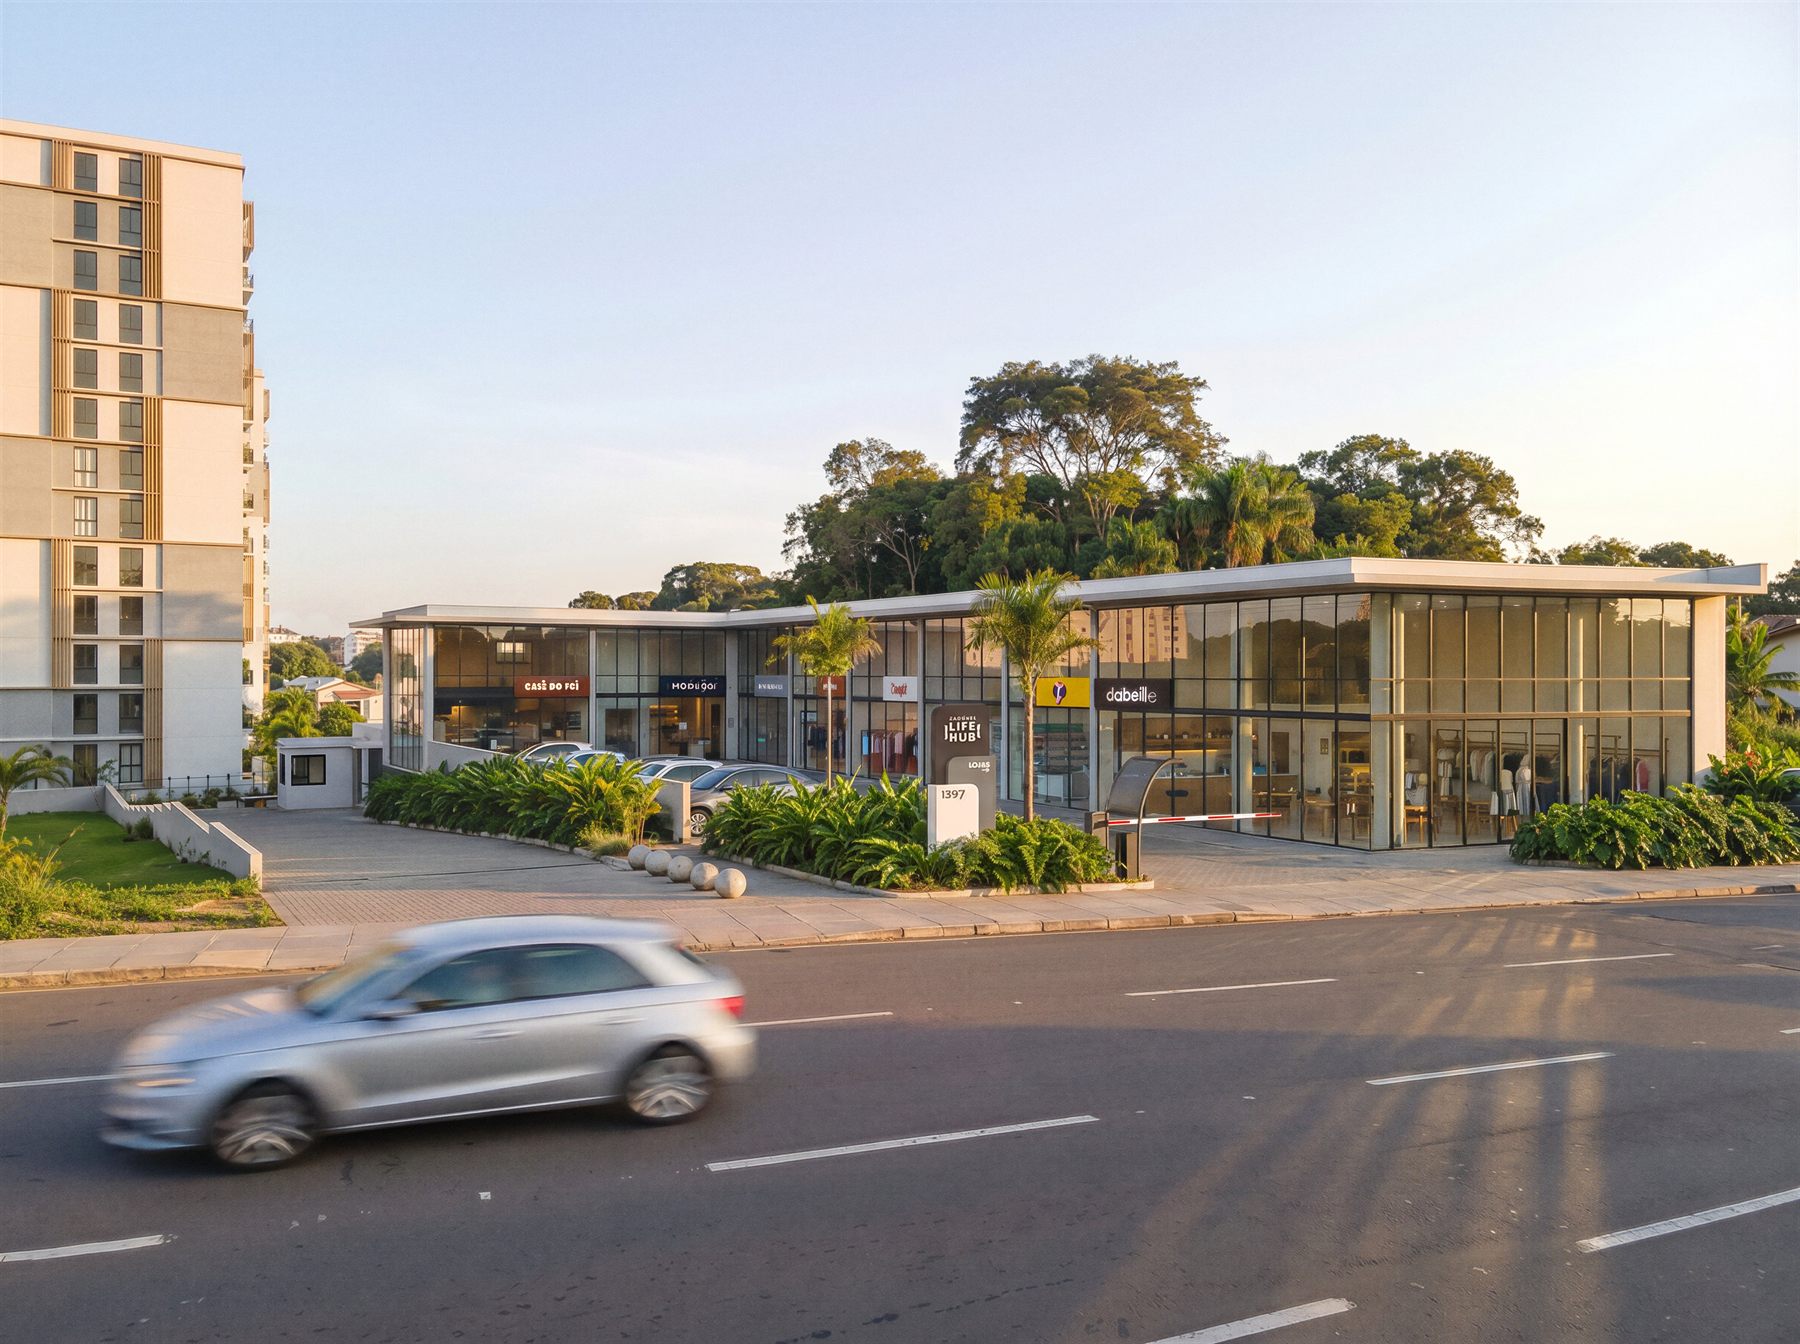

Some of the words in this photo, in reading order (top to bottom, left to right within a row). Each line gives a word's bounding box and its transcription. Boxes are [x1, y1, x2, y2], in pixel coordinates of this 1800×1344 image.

[549, 682, 563, 691] DO
[1106, 686, 1157, 703] dabeille
[949, 721, 976, 732] LIFE
[949, 732, 976, 743] HUB
[968, 761, 991, 769] LOJAS
[941, 789, 966, 800] 1397
